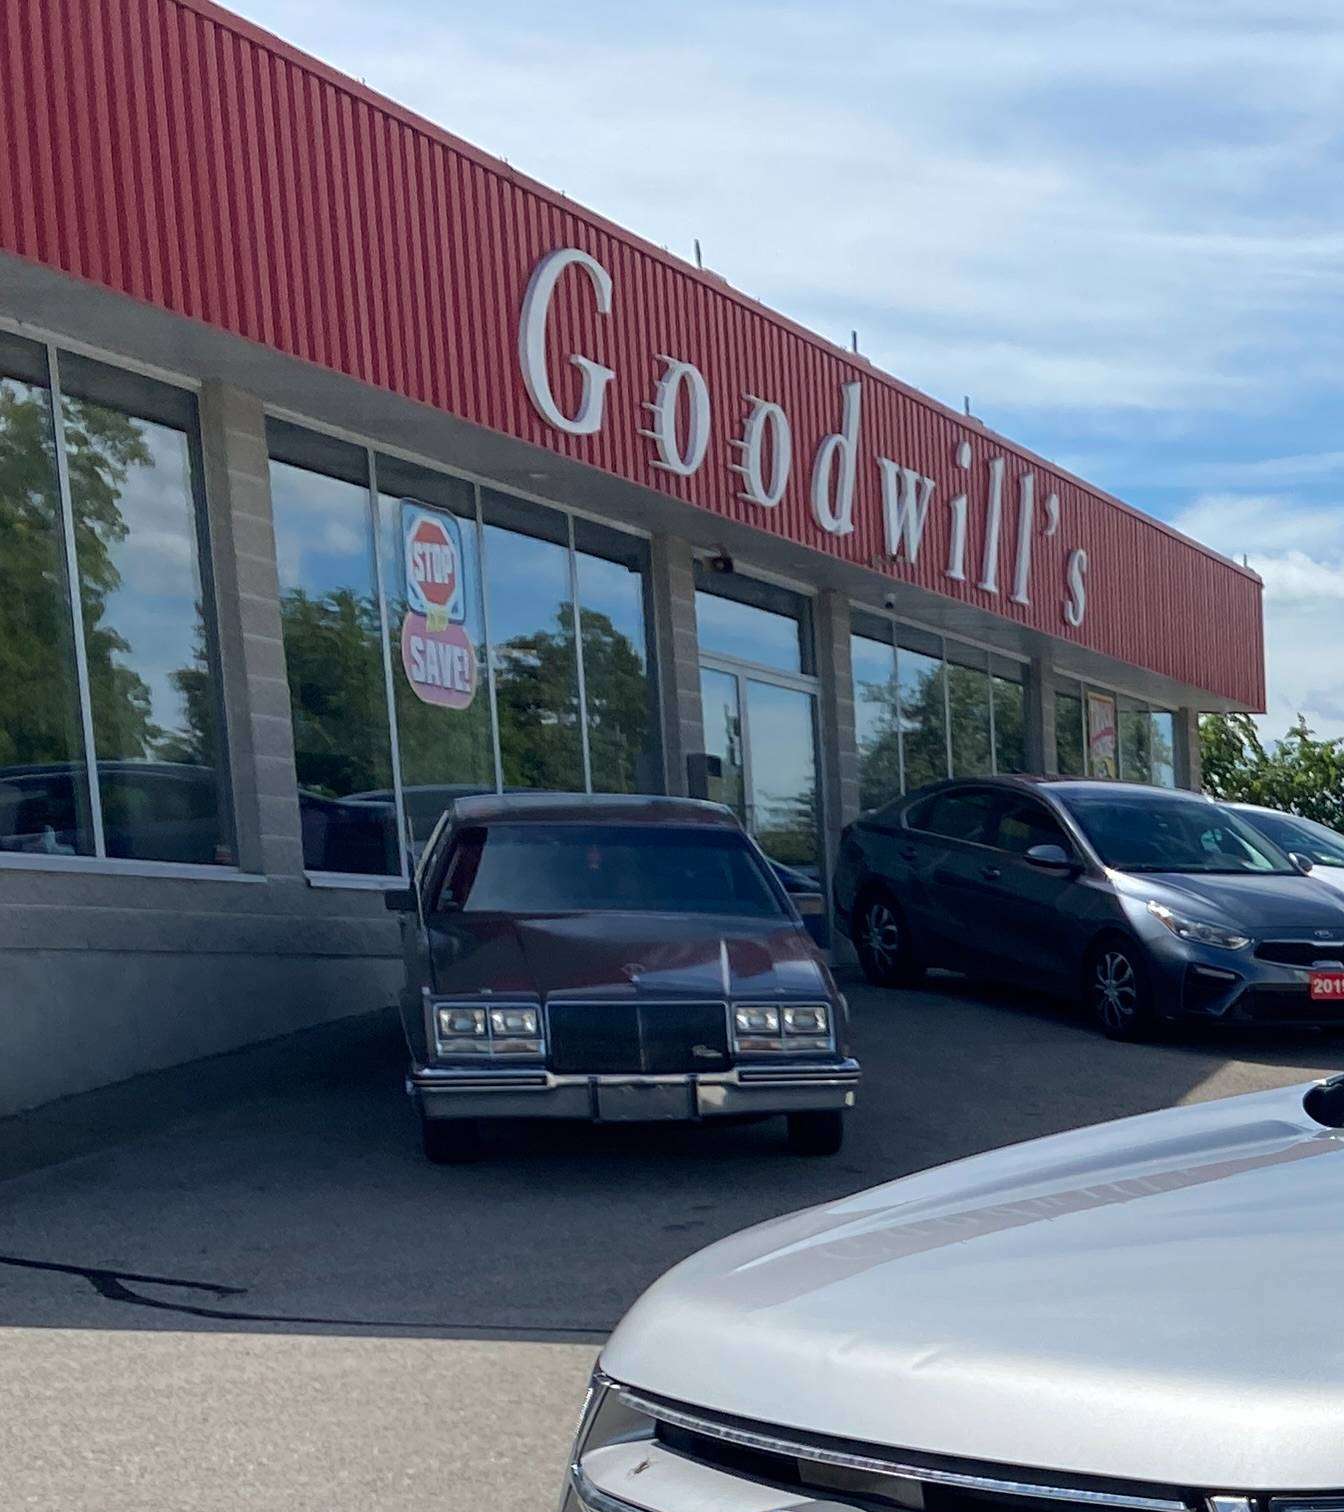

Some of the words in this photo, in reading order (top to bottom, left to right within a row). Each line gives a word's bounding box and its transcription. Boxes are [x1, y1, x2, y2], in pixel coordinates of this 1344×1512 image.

[517, 246, 1089, 629] Goodwill's
[412, 541, 454, 585] STOP
[410, 634, 472, 693] SAVE!
